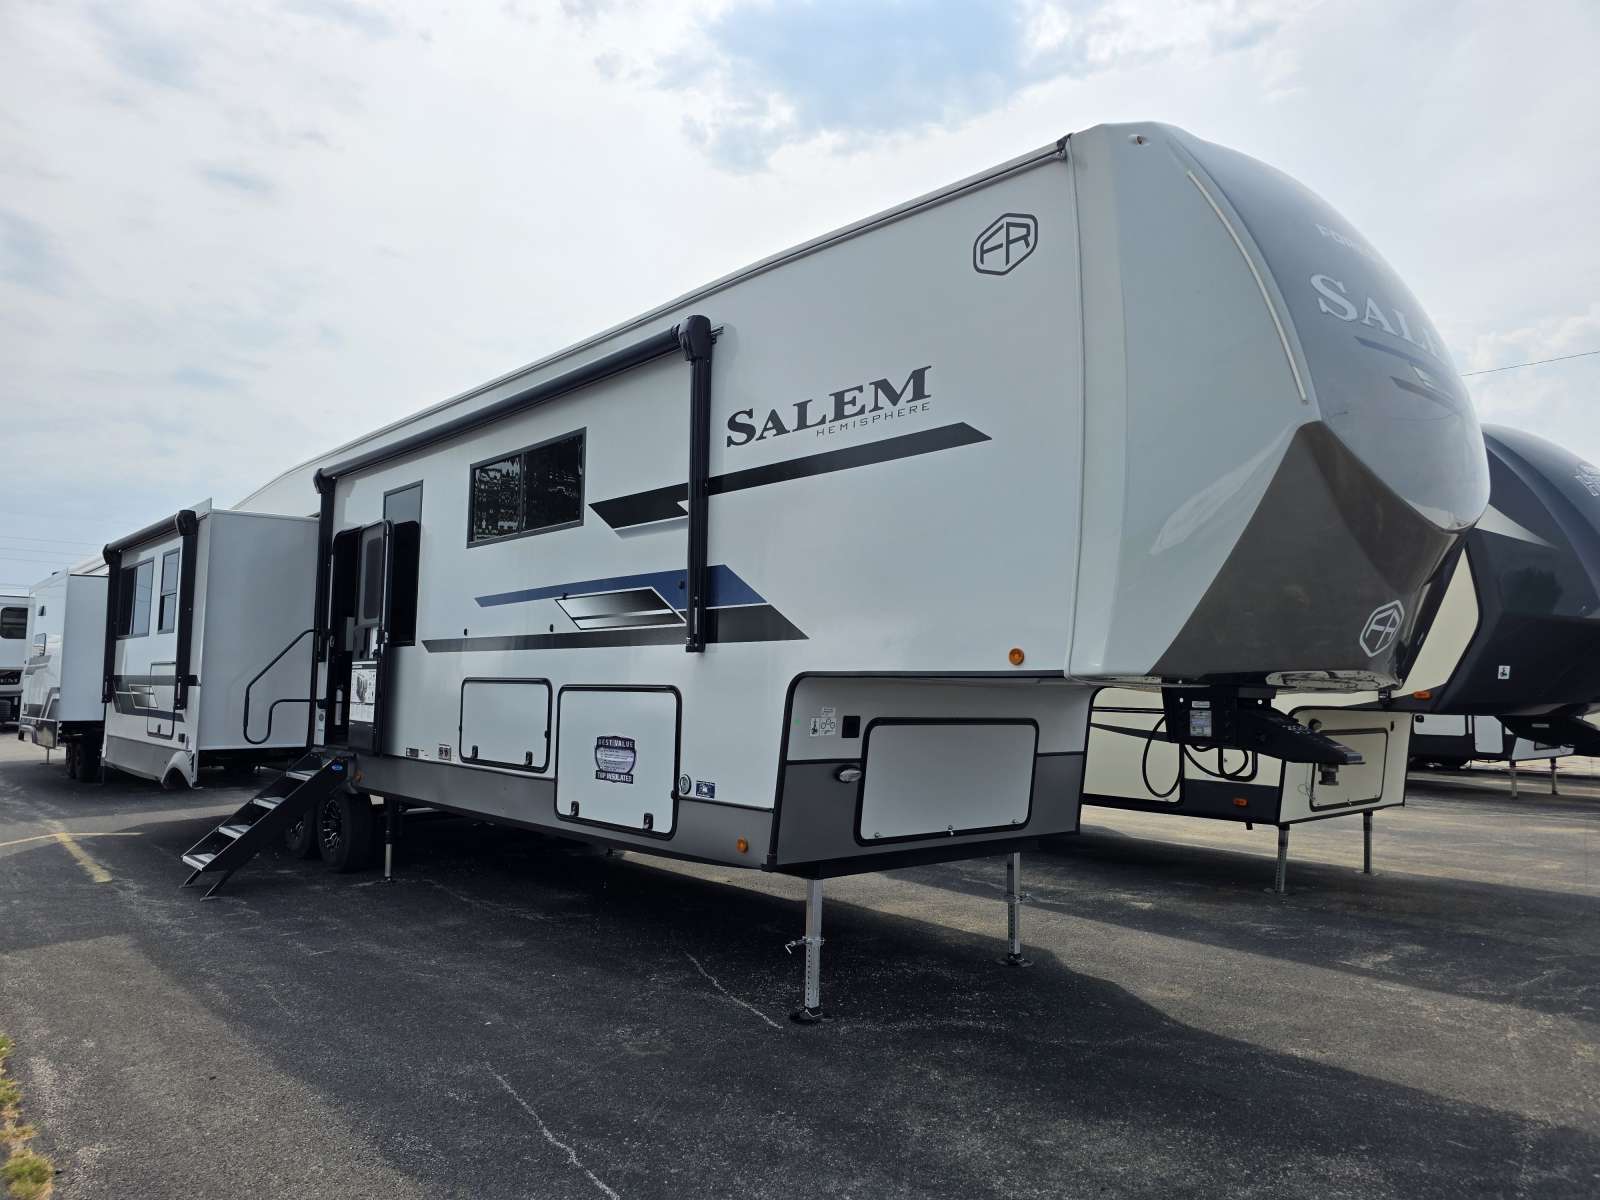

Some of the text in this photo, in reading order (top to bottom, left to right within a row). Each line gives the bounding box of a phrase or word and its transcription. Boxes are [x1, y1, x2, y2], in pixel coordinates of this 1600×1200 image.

[726, 365, 932, 448] SALEM
[815, 401, 931, 439] HEMISPHERE
[614, 739, 634, 748] VALUE
